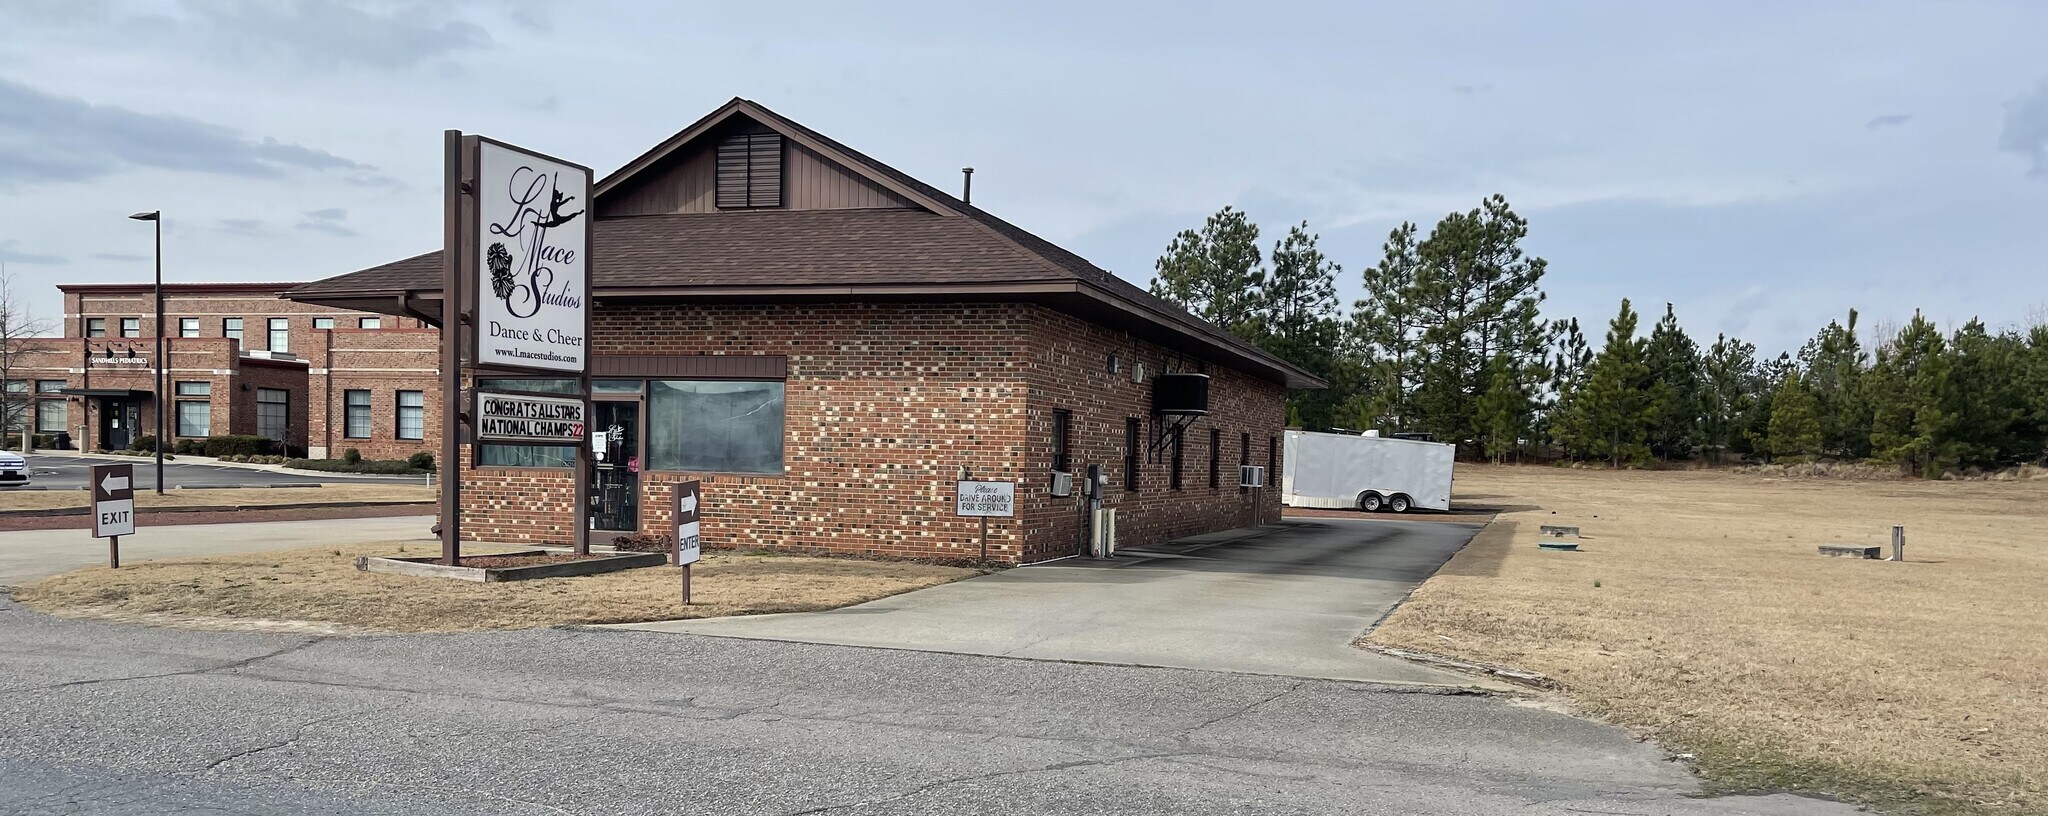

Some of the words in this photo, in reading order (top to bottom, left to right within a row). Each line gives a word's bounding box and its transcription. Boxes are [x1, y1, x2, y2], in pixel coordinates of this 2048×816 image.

[512, 208, 576, 277] Mace
[506, 267, 582, 319] Studios
[489, 321, 529, 341] Dance
[532, 328, 544, 343] &
[547, 328, 583, 346] Cheer
[495, 347, 577, 363] www.Lmacestudios.com
[484, 400, 537, 418] CONGRATS
[539, 404, 581, 420] ALLSTARS
[482, 419, 533, 436] NATIONAL
[962, 502, 975, 511] FOR
[977, 503, 1009, 512] SERVICE
[101, 510, 129, 525] EXIT
[680, 534, 699, 551] ENTER
